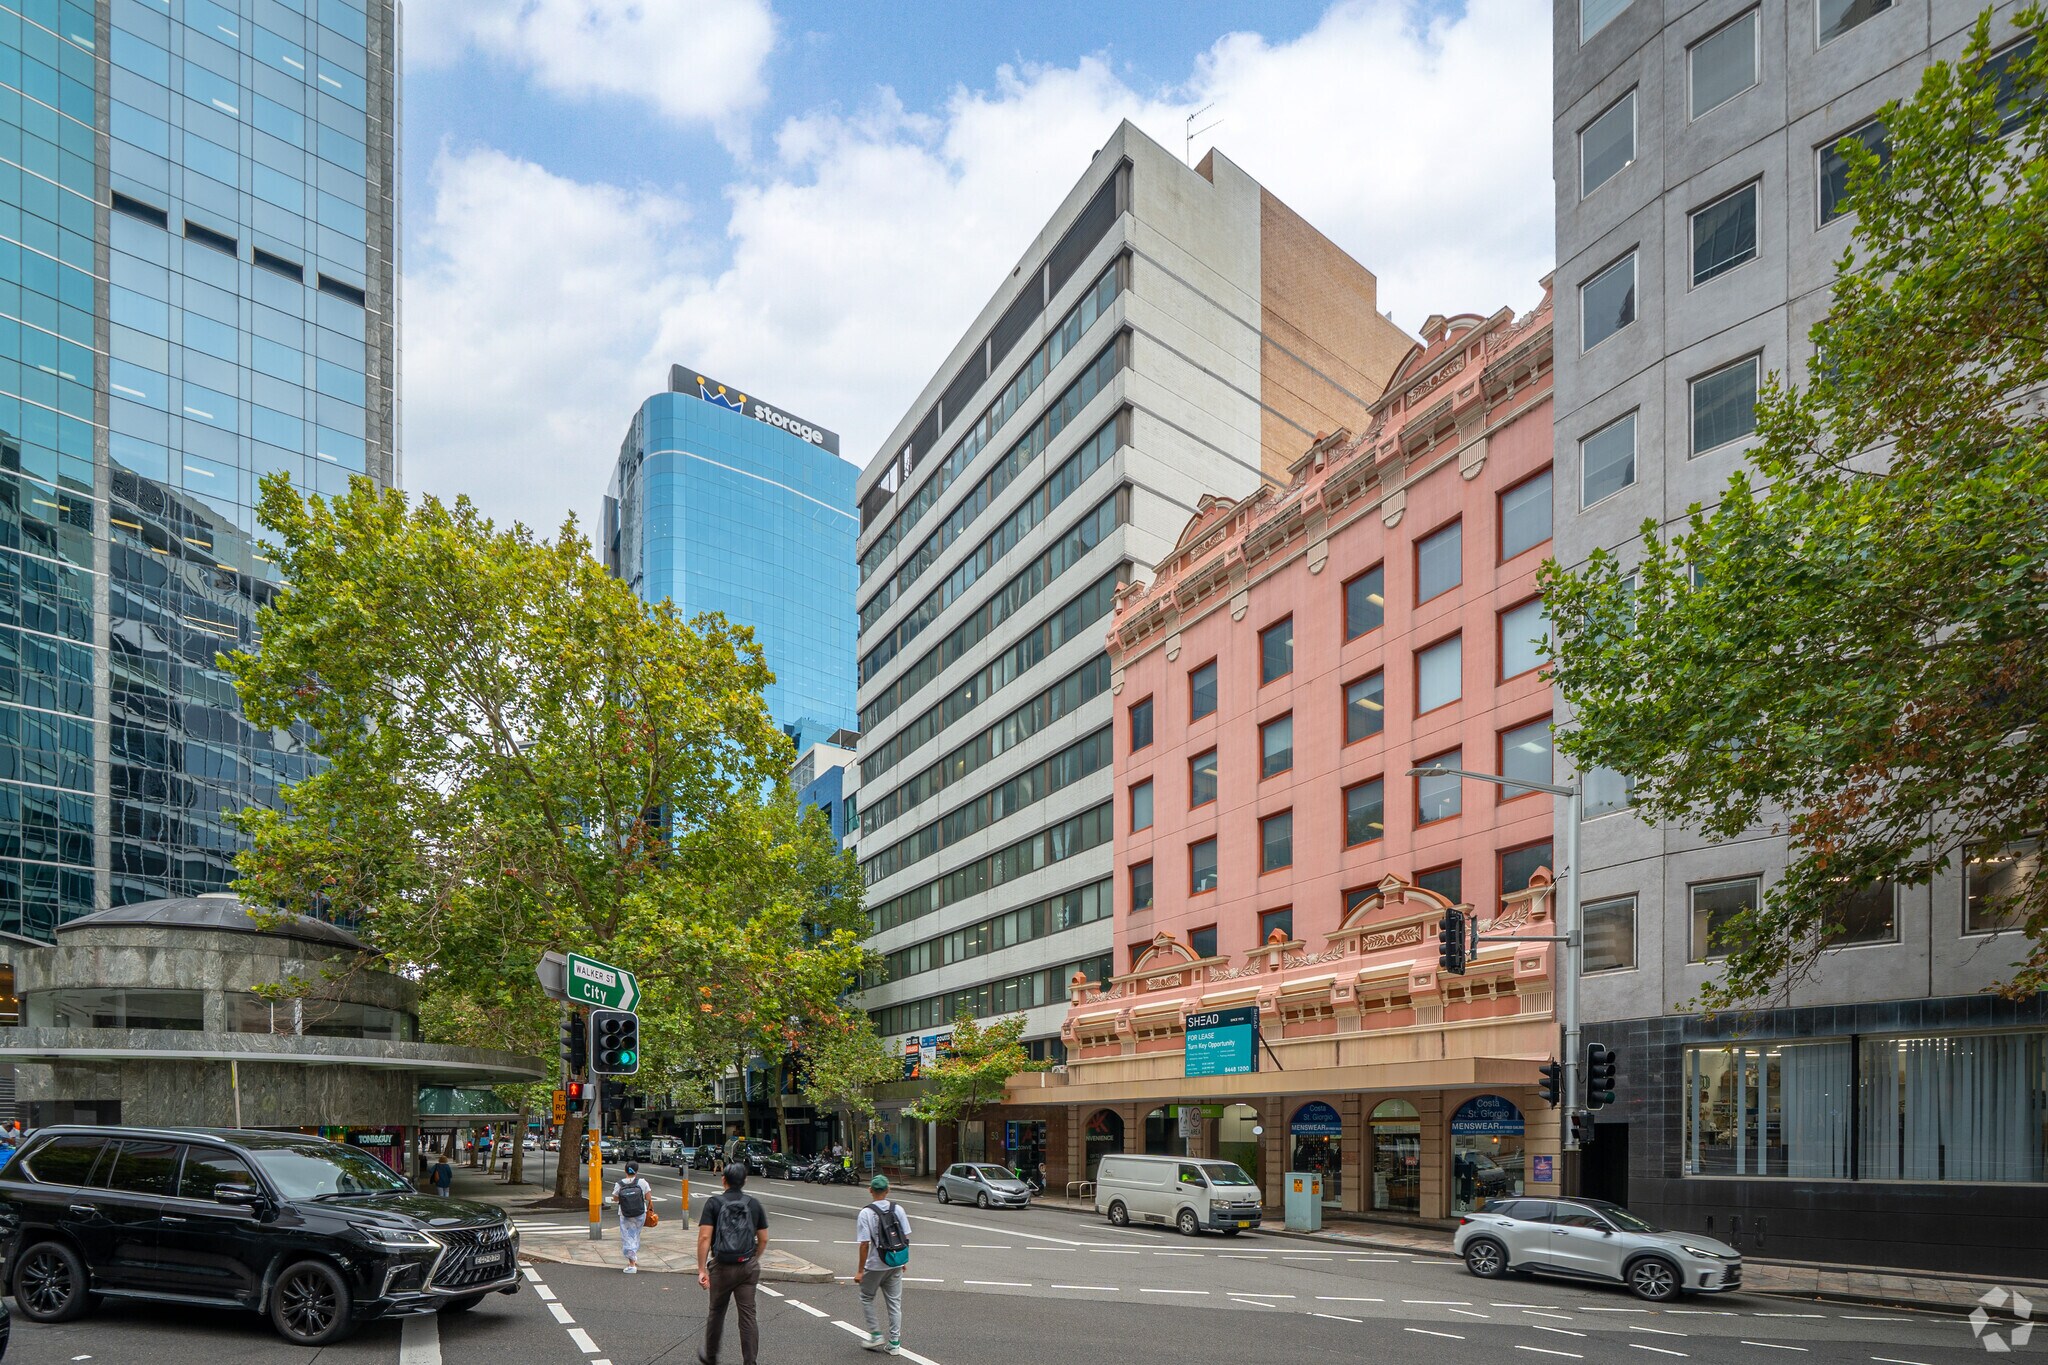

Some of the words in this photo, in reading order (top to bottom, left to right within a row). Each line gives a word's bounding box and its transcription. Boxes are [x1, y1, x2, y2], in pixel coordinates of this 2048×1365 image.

[754, 404, 823, 444] storage
[576, 965, 603, 980] WALKER
[606, 974, 614, 983] ST
[584, 983, 606, 1004] City
[1188, 1014, 1218, 1027] SHEAD
[1208, 1040, 1235, 1049] Opportunity
[1481, 1110, 1509, 1119] Giorgio
[358, 1135, 392, 1144] TONI&GUY
[991, 1132, 999, 1140] 53
